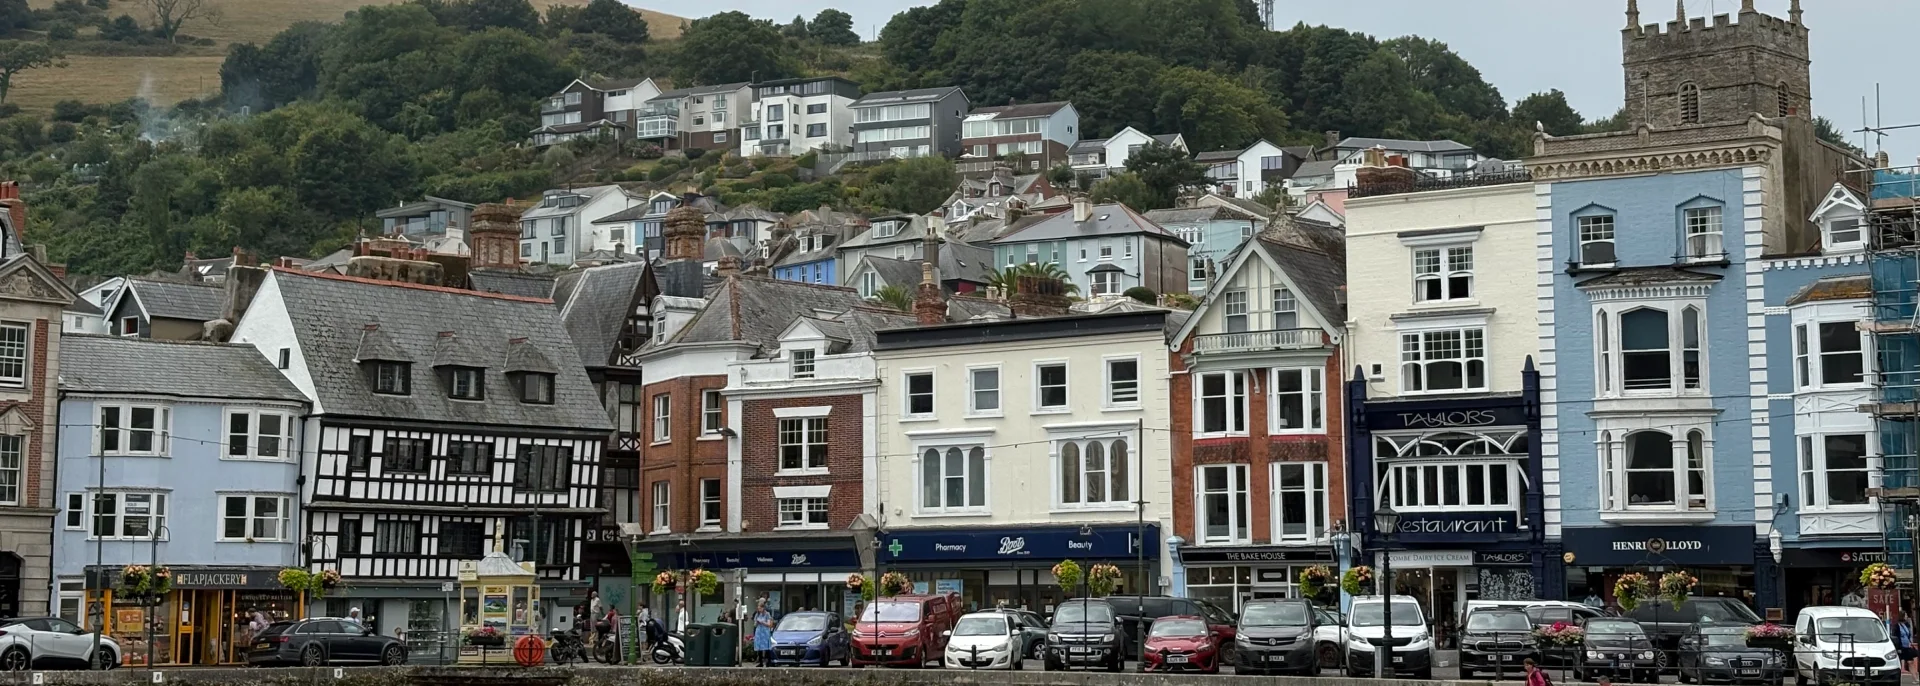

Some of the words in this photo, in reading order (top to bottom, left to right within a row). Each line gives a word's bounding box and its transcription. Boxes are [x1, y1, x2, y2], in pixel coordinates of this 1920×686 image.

[1397, 410, 1496, 427] TAYLORS
[1395, 515, 1507, 533] Restaurant
[935, 543, 966, 553] Pharmacy
[997, 536, 1025, 555] Boots
[1068, 540, 1092, 551] Beauty
[1612, 541, 1647, 550] HENRI
[1666, 541, 1701, 550] LLOYD
[1226, 552, 1239, 560] THE
[1240, 552, 1260, 560] BAKE
[1260, 552, 1286, 560] HOUSE
[1446, 553, 1469, 561] CREAM
[1481, 553, 1525, 562] TAYLORS
[1852, 551, 1887, 562] SALTRO
[183, 573, 241, 586] FLAPJACKERY
